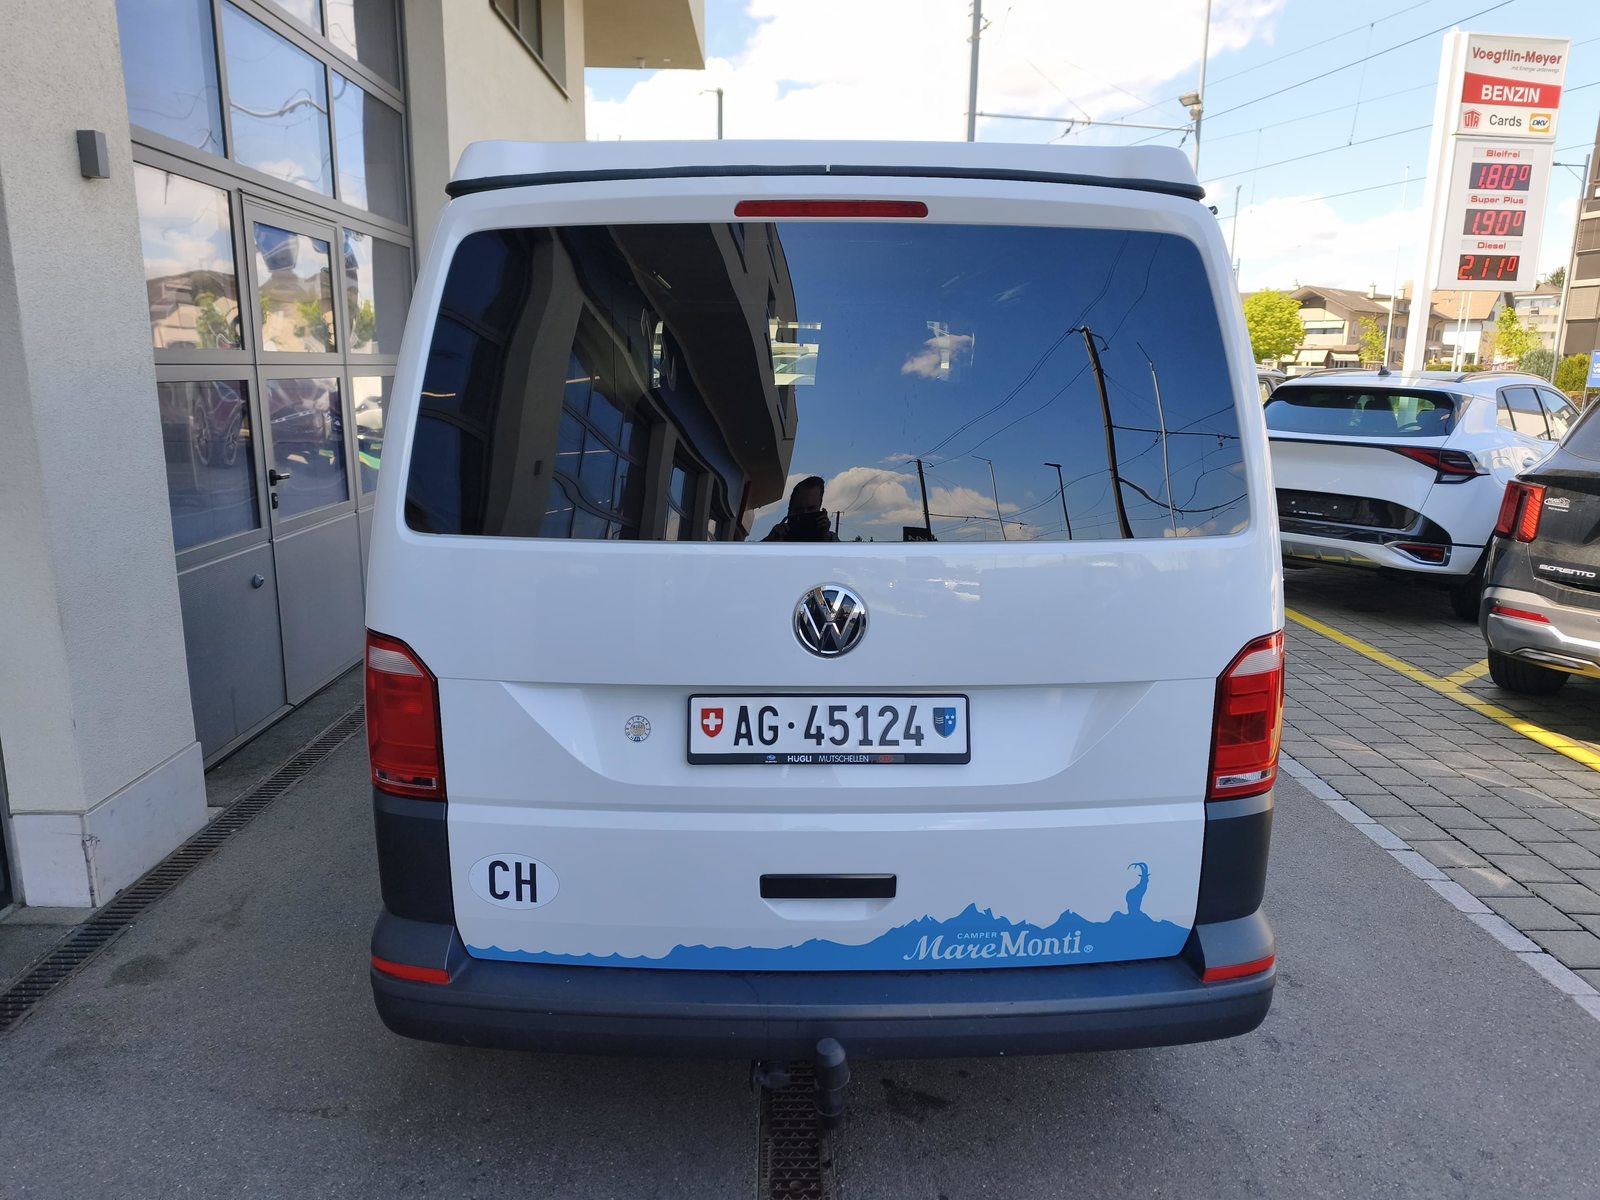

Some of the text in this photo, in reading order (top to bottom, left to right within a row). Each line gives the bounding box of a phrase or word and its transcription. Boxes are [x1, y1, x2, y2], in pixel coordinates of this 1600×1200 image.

[1472, 47, 1562, 66] Voegtlin-Meyer
[1481, 84, 1541, 104] BENZIN
[1489, 114, 1522, 127] Cards
[1531, 119, 1549, 127] DKV
[1486, 149, 1520, 159] Bleifrei
[1470, 195, 1524, 205] Super Plus
[1477, 241, 1507, 250] Diesel
[818, 755, 869, 763] MUTSCHELLEN
[488, 860, 538, 903] CH
[956, 932, 998, 940] CAMPER
